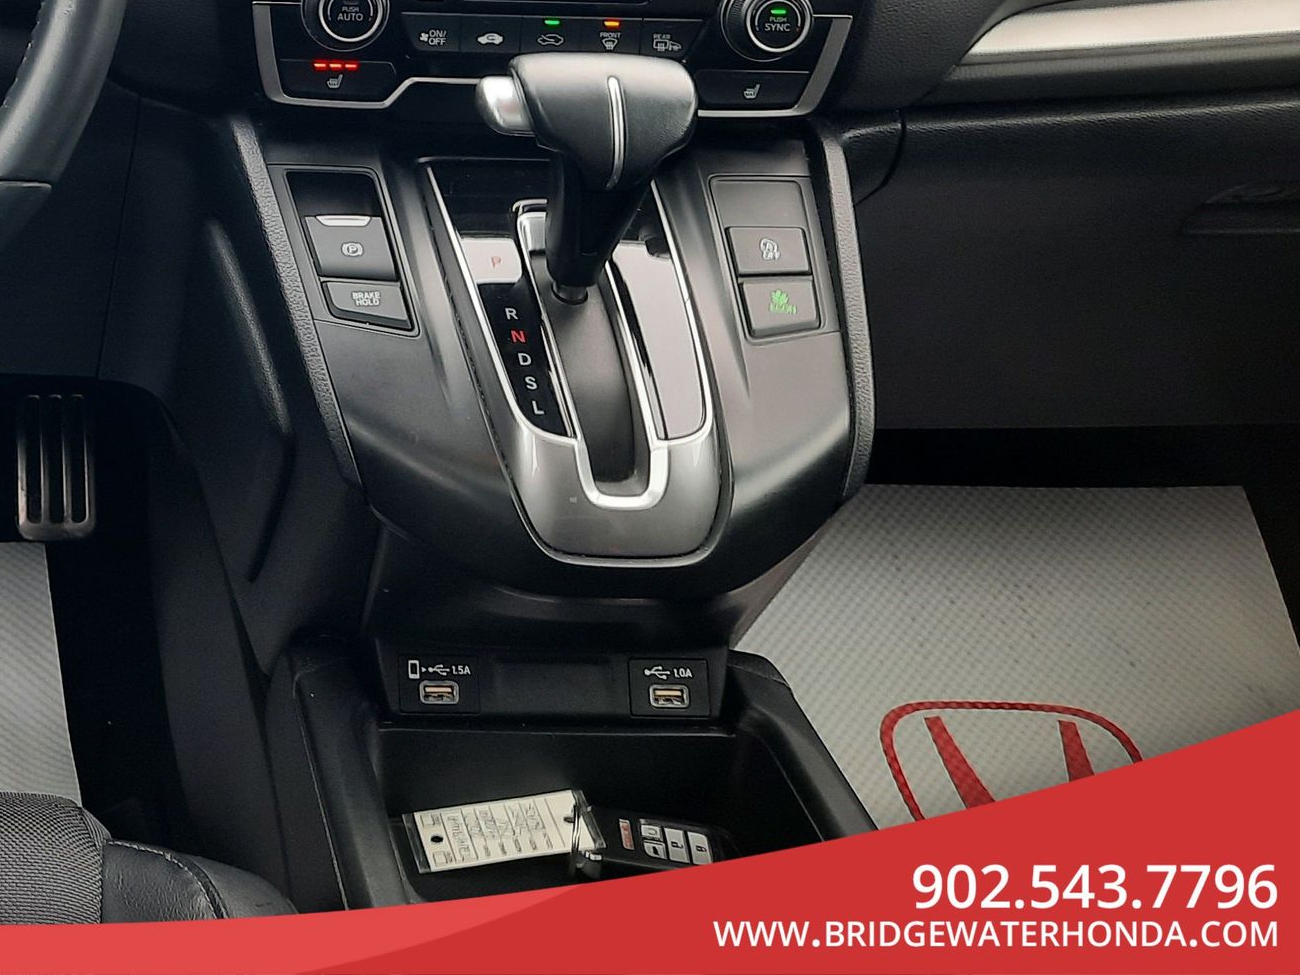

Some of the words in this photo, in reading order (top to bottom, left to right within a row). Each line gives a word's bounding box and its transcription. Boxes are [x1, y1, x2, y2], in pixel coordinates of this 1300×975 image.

[337, 13, 364, 22] AUTO
[764, 23, 791, 32] SYNC
[429, 29, 447, 38] ON/
[429, 37, 446, 46] OFF
[491, 256, 502, 268] P
[352, 291, 380, 299] BRAKE
[355, 298, 380, 306] HOLD
[505, 307, 519, 320] R
[511, 330, 526, 343] N
[518, 353, 532, 366] D
[525, 376, 538, 390] S
[532, 400, 545, 415] L
